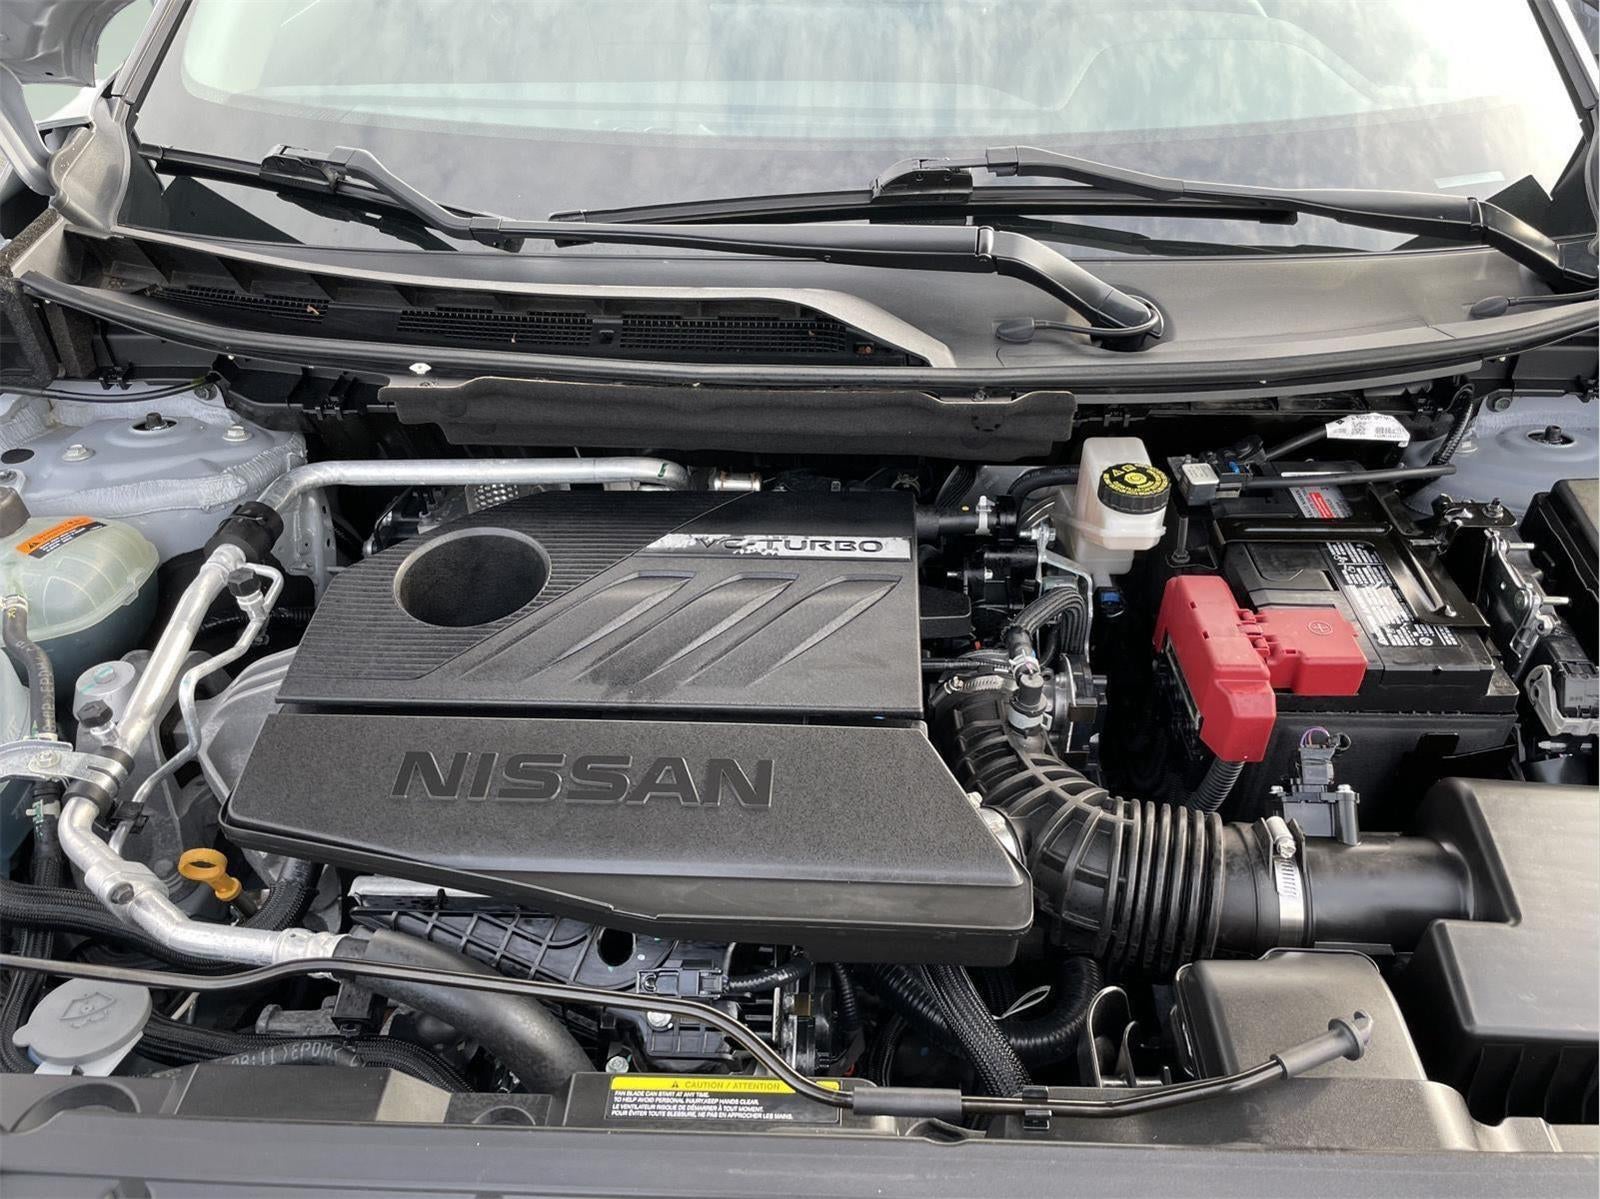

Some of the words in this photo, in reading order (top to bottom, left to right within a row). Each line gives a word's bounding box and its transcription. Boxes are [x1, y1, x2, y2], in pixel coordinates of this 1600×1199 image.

[390, 750, 775, 808] NISSAN
[684, 1081, 724, 1089] CAUTION
[732, 1082, 781, 1090] ATTENTION
